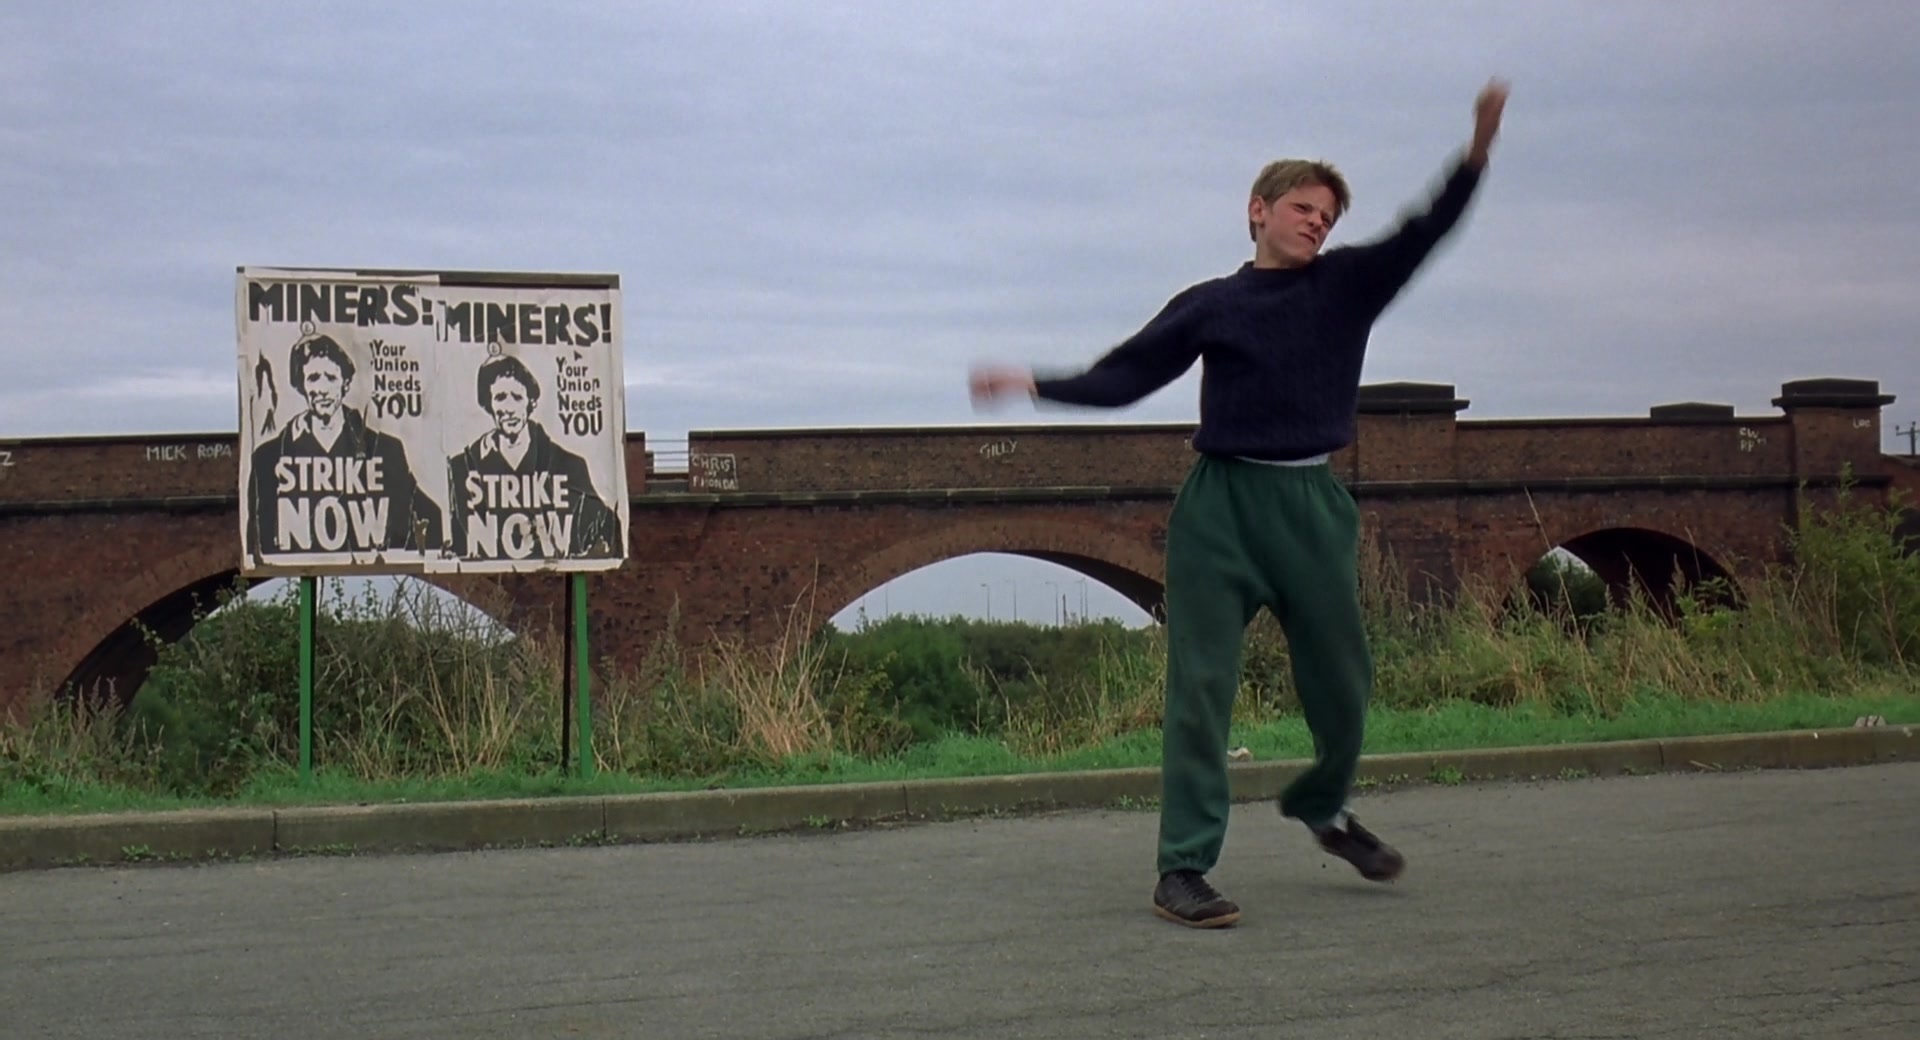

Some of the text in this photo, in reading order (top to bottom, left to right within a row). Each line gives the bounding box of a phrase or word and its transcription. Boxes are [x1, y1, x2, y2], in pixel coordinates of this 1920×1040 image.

[249, 282, 433, 327] MINERS!
[437, 301, 612, 347] MINERS!
[373, 339, 406, 357] Your
[374, 358, 419, 372] Union
[556, 356, 588, 377] Your
[374, 374, 421, 392] Needs
[557, 374, 600, 392] Union
[371, 392, 422, 419] YOU
[557, 391, 602, 411] Needs
[558, 409, 603, 436] YOU
[146, 444, 187, 461] MICK
[979, 438, 1018, 458] GILLY
[691, 455, 731, 472] CHRIS
[275, 456, 384, 494] STRIKE
[465, 470, 569, 509] STRIKE
[277, 495, 390, 551] NOW
[466, 510, 573, 559] NOW
